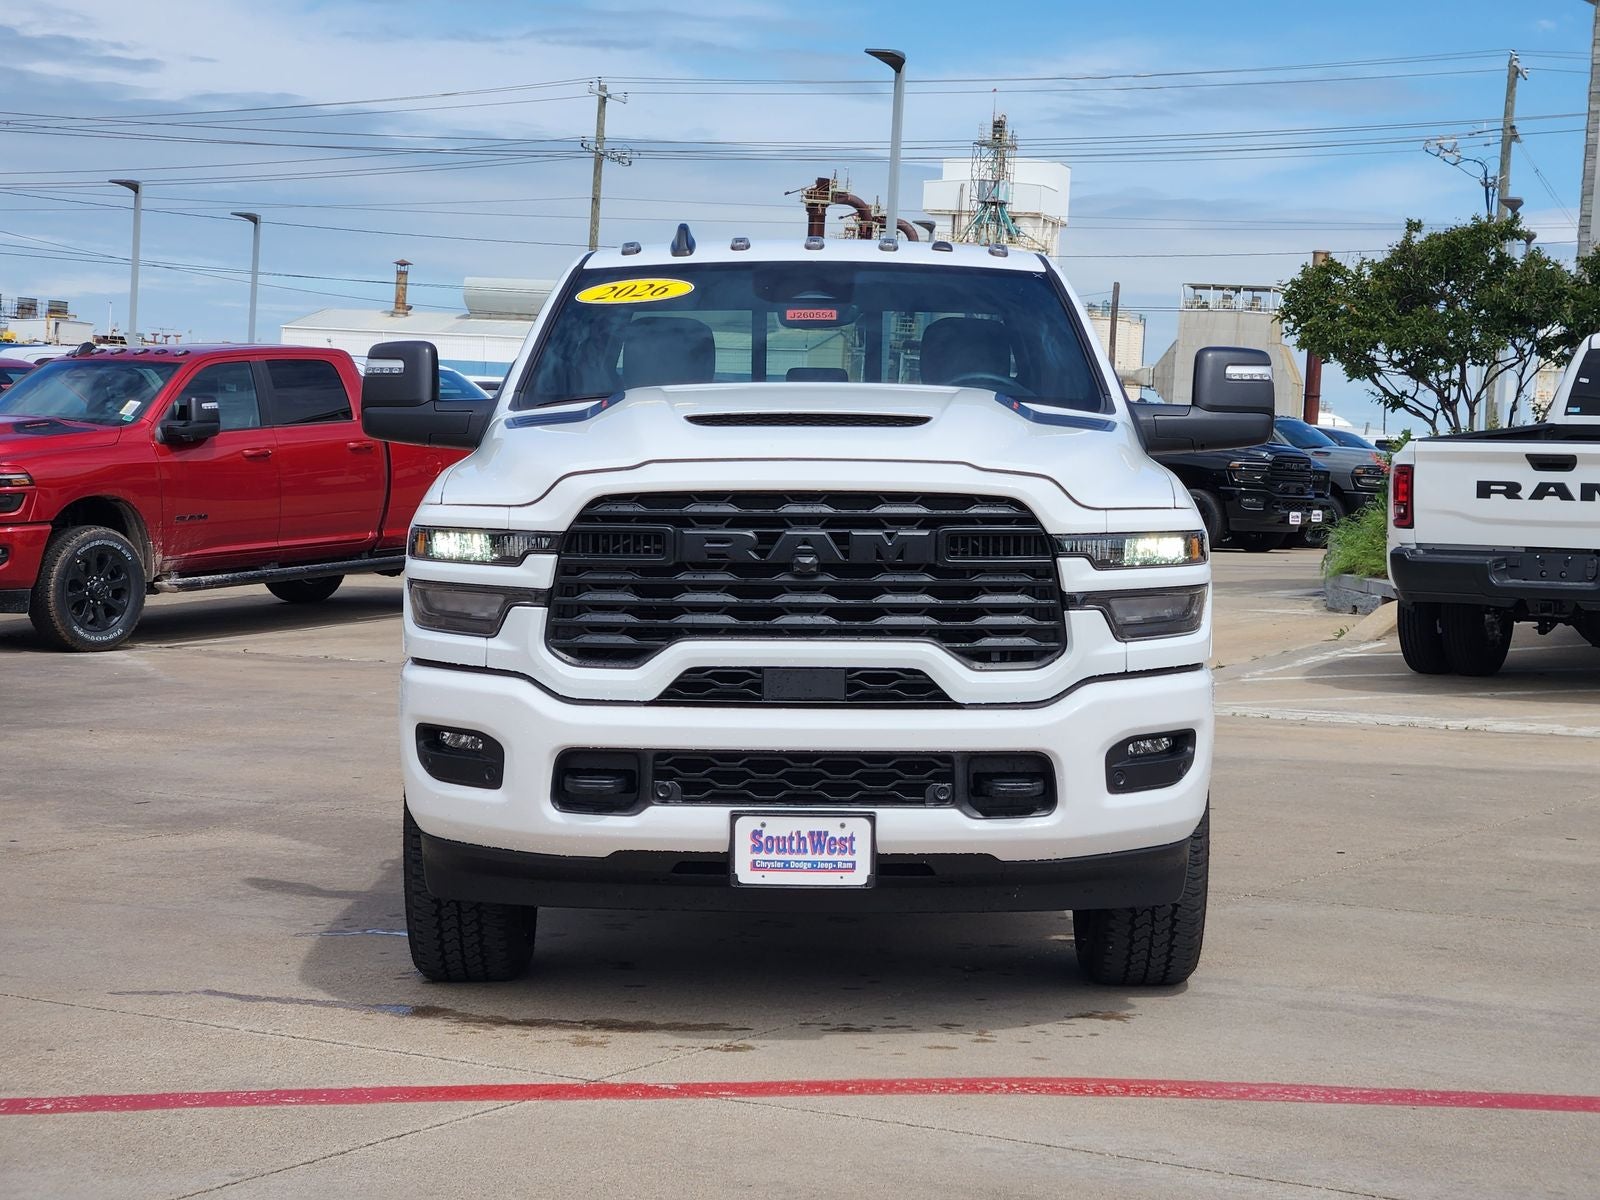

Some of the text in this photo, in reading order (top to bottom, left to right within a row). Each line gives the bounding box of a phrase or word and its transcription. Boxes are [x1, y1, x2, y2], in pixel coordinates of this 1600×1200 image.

[592, 283, 676, 301] 2026
[790, 311, 833, 319] J260554
[682, 529, 934, 563] RAM
[749, 829, 856, 856] SouthWest
[755, 860, 784, 869] Chrysler
[790, 861, 812, 869] Dodge
